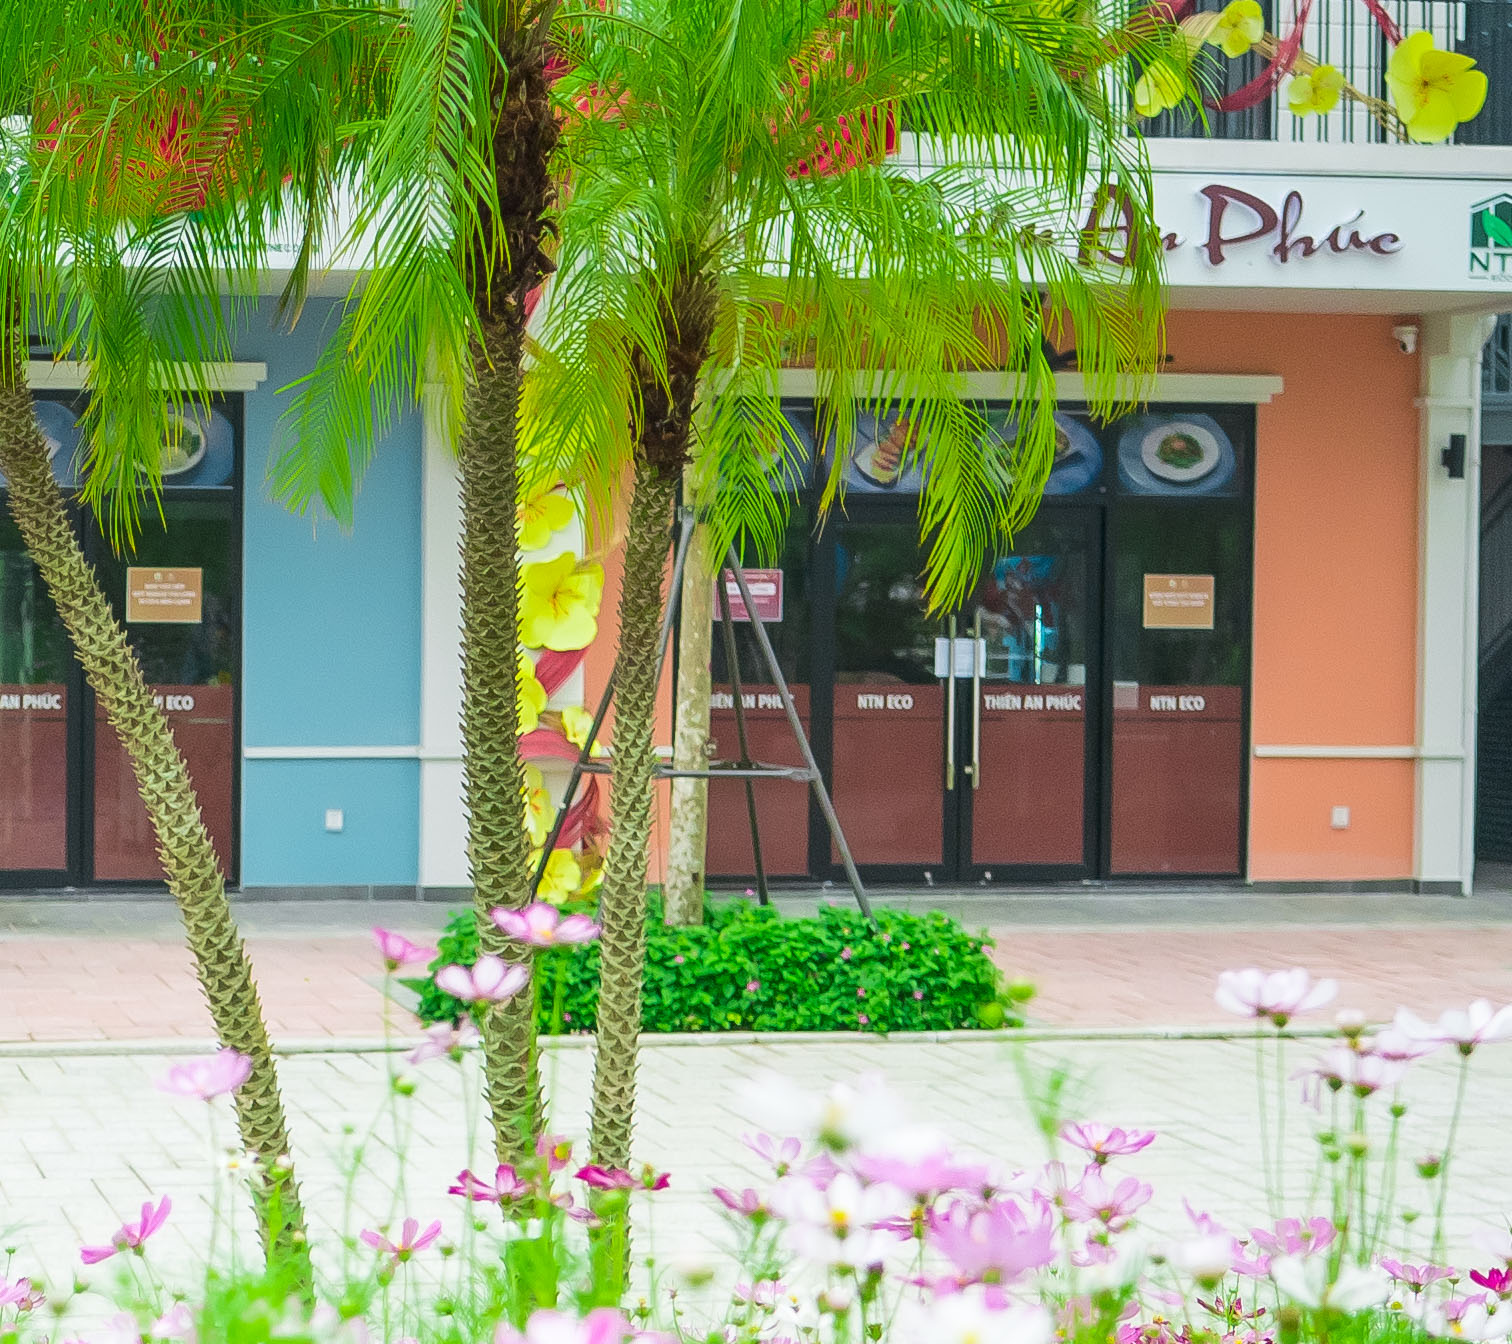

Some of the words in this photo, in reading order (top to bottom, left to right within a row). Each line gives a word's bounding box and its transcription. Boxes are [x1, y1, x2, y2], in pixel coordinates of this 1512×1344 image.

[1198, 184, 1403, 266] Phúc
[0, 694, 21, 710] AN
[22, 692, 62, 710] PHÚC
[166, 694, 195, 711] ECO
[857, 694, 884, 709] NTN
[886, 694, 914, 710] ECO
[1024, 694, 1044, 710] AN
[1150, 694, 1177, 711] NTN
[1178, 694, 1206, 711] ECO
